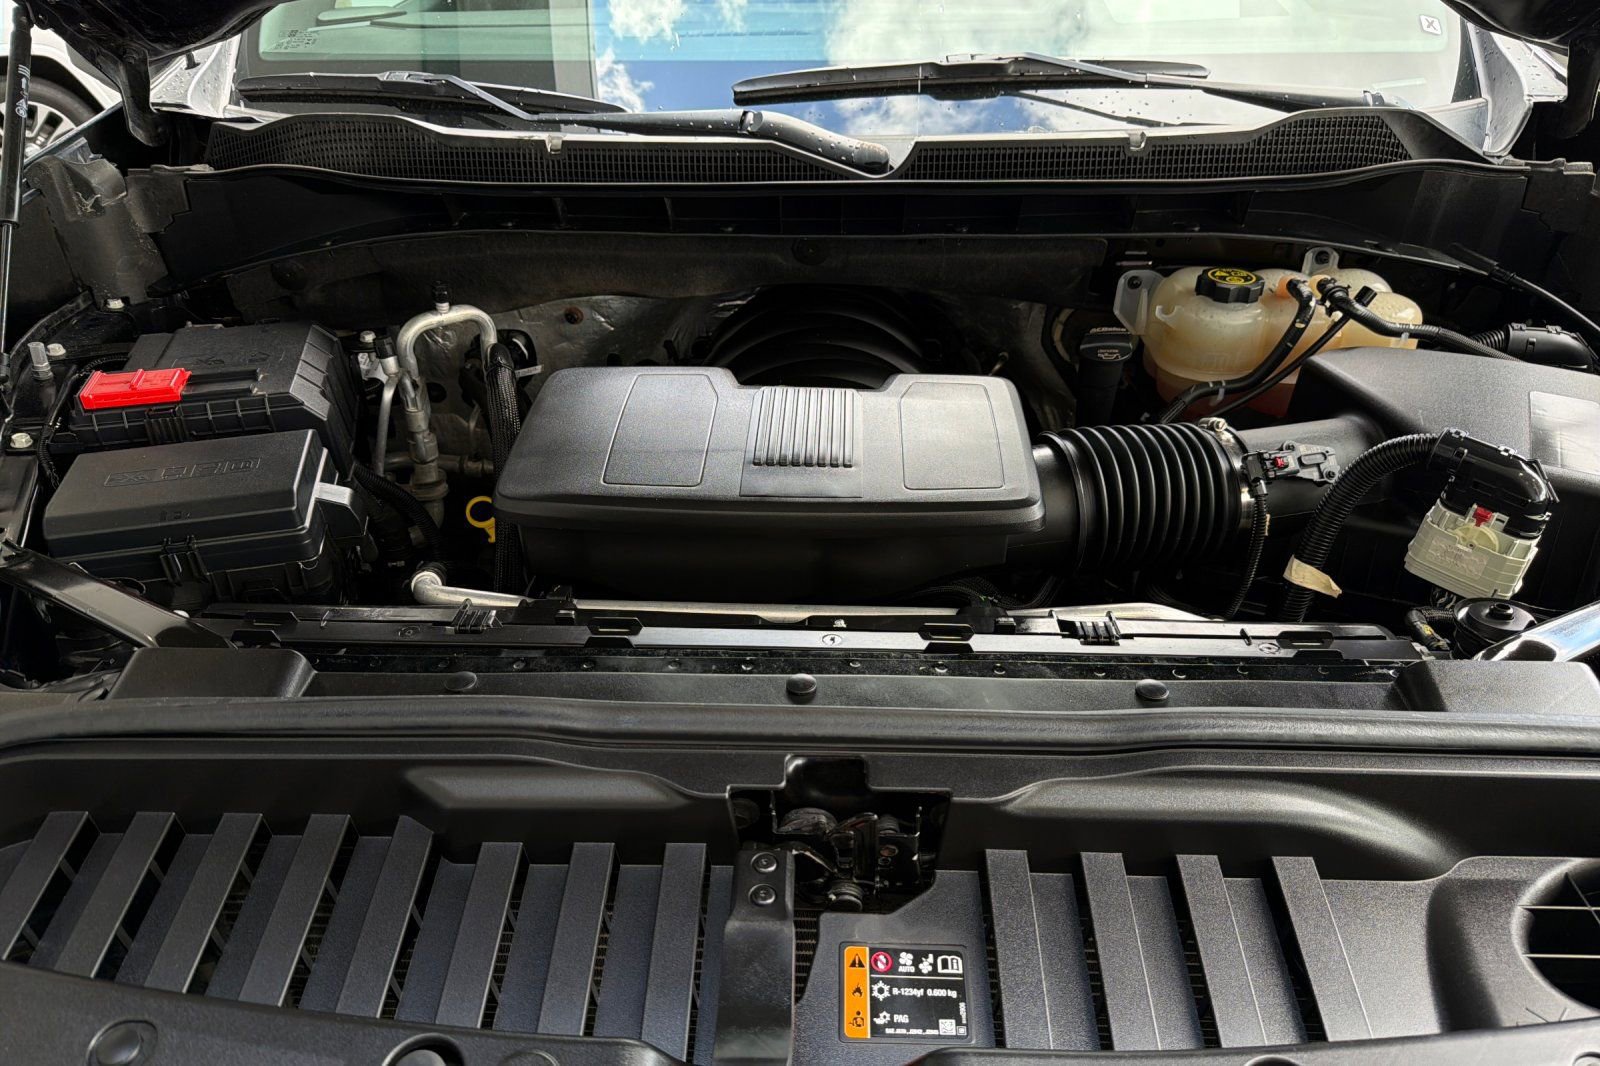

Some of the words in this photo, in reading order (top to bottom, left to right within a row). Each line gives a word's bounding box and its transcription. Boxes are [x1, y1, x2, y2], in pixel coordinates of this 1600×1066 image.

[892, 987, 924, 997] R-1234yf
[947, 988, 957, 998] kg
[893, 1014, 909, 1023] PAG
